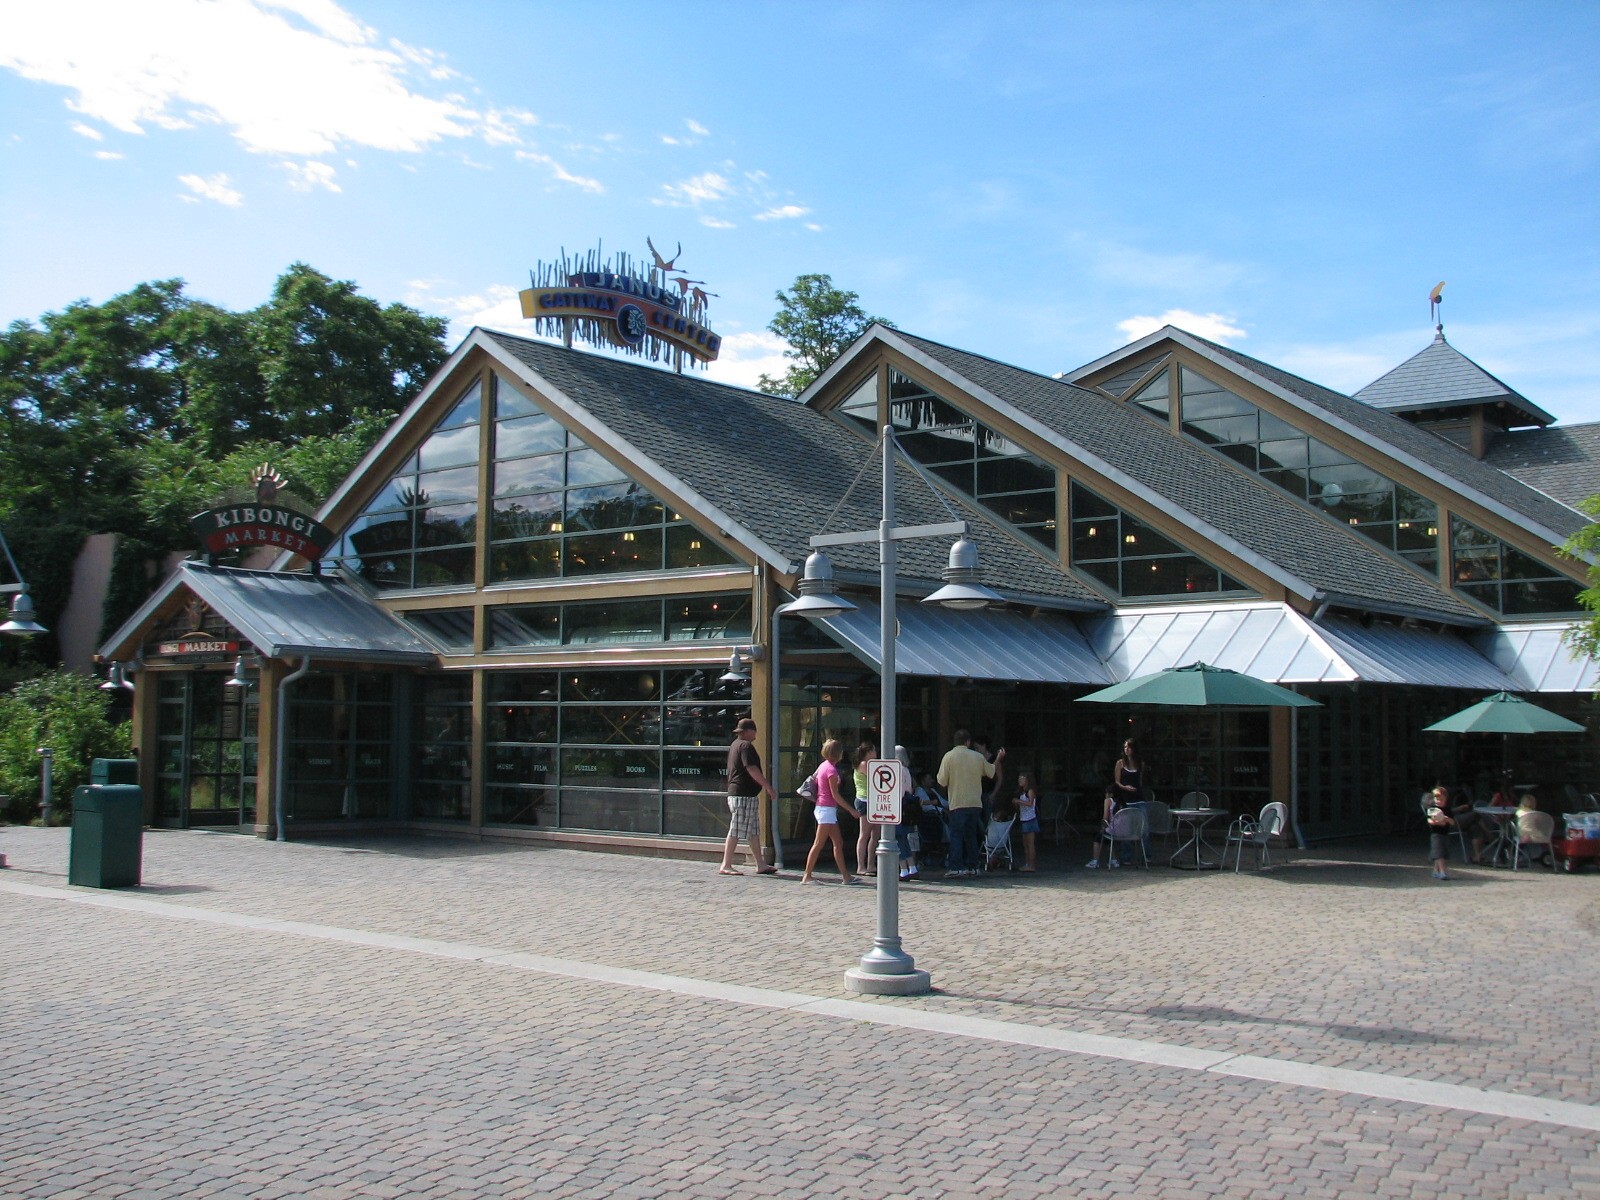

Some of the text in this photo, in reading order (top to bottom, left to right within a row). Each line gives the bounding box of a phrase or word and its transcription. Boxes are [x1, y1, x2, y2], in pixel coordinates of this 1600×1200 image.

[595, 273, 676, 305] JANUS
[215, 508, 315, 537] KIBONGI
[225, 529, 306, 550] MARKET
[184, 641, 228, 652] MARKET
[672, 767, 700, 775] T-SHIRTS
[877, 795, 891, 803] FIRE
